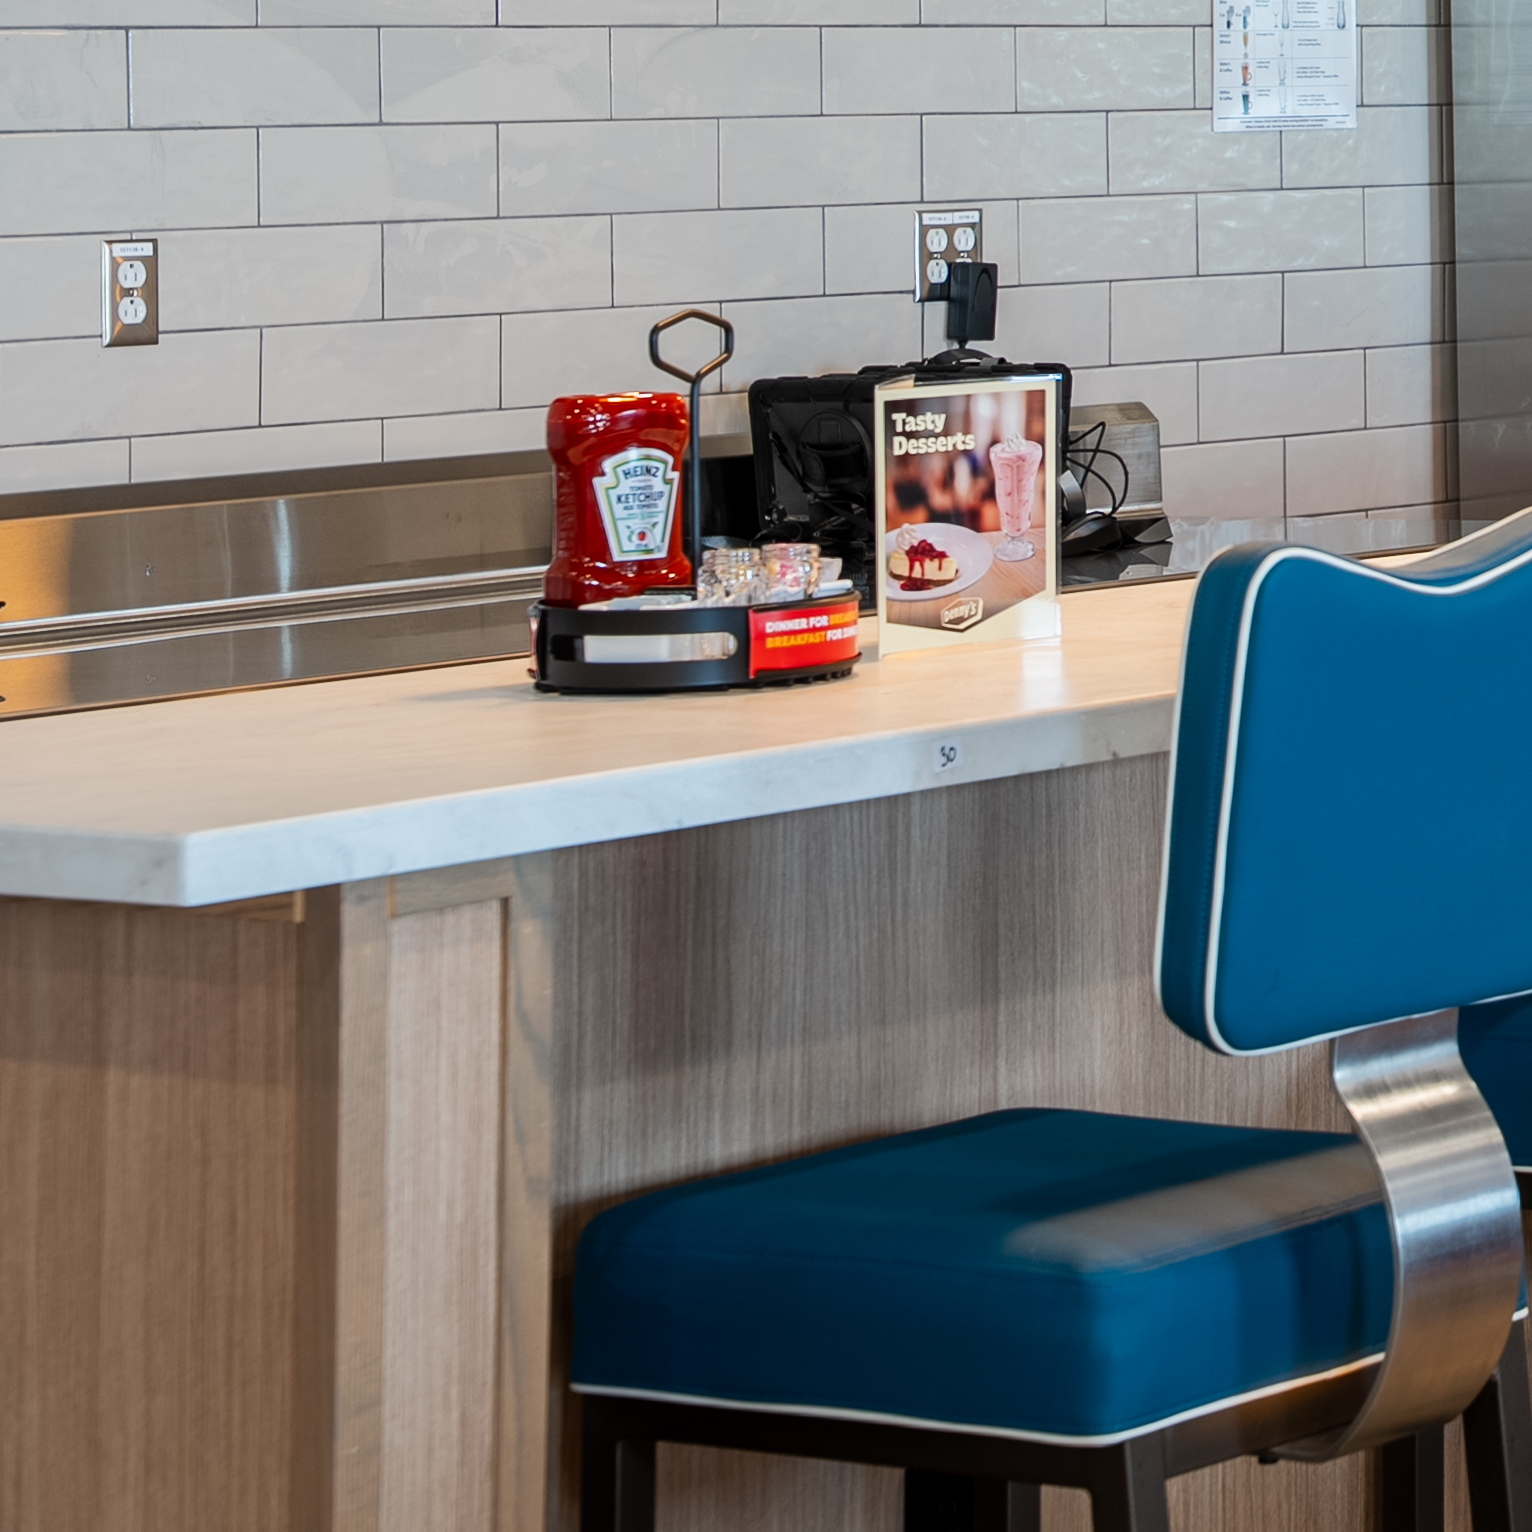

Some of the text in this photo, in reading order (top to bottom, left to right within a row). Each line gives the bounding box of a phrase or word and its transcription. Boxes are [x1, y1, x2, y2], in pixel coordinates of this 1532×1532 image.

[891, 412, 946, 434] Tasty
[893, 432, 976, 456] Desserts
[622, 465, 661, 480] HEINZ
[616, 491, 665, 504] KETCHUP
[944, 601, 977, 623] Denny's
[765, 618, 808, 633] DINNER
[809, 615, 829, 628] FOR
[766, 631, 825, 648] BREAKFAST
